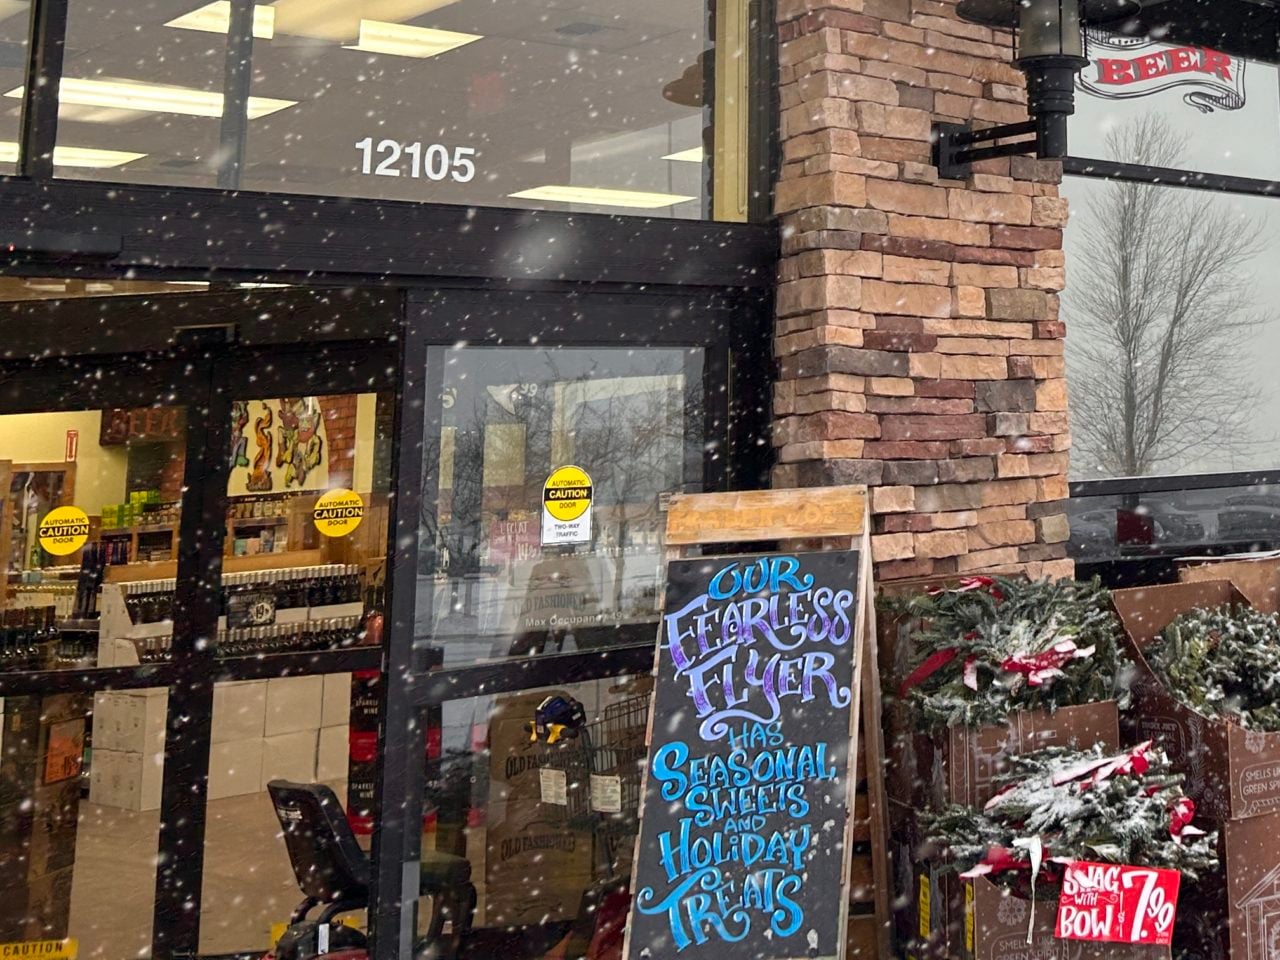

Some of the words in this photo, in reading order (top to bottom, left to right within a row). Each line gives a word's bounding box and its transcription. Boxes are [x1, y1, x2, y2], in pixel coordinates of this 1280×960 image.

[1094, 45, 1233, 86] BEER
[355, 137, 475, 183] 12105
[552, 479, 586, 487] AUTOMATIC
[549, 489, 588, 500] CAUTION
[318, 499, 360, 508] AUTOMATIC
[559, 501, 577, 509] DOOR
[313, 507, 363, 519] CAUTION
[45, 517, 86, 526] AUTOMATIC
[327, 519, 348, 527] DOOR
[39, 525, 89, 537] CAUTION
[709, 556, 815, 600] OUR
[661, 587, 853, 680] FEARLESS
[683, 644, 851, 740] FLYER
[728, 721, 784, 749] HAS
[652, 742, 836, 801] SEASONAL
[1245, 767, 1271, 782] SMELLS
[1243, 782, 1267, 796] GREEN
[685, 780, 810, 827] SWEETS
[724, 815, 767, 835] AND
[1075, 892, 1099, 906] WITH
[637, 866, 805, 952] TREATS
[1060, 905, 1114, 938] BOW
[3, 942, 63, 957] CAUTION
[999, 938, 1030, 951] SMELL
